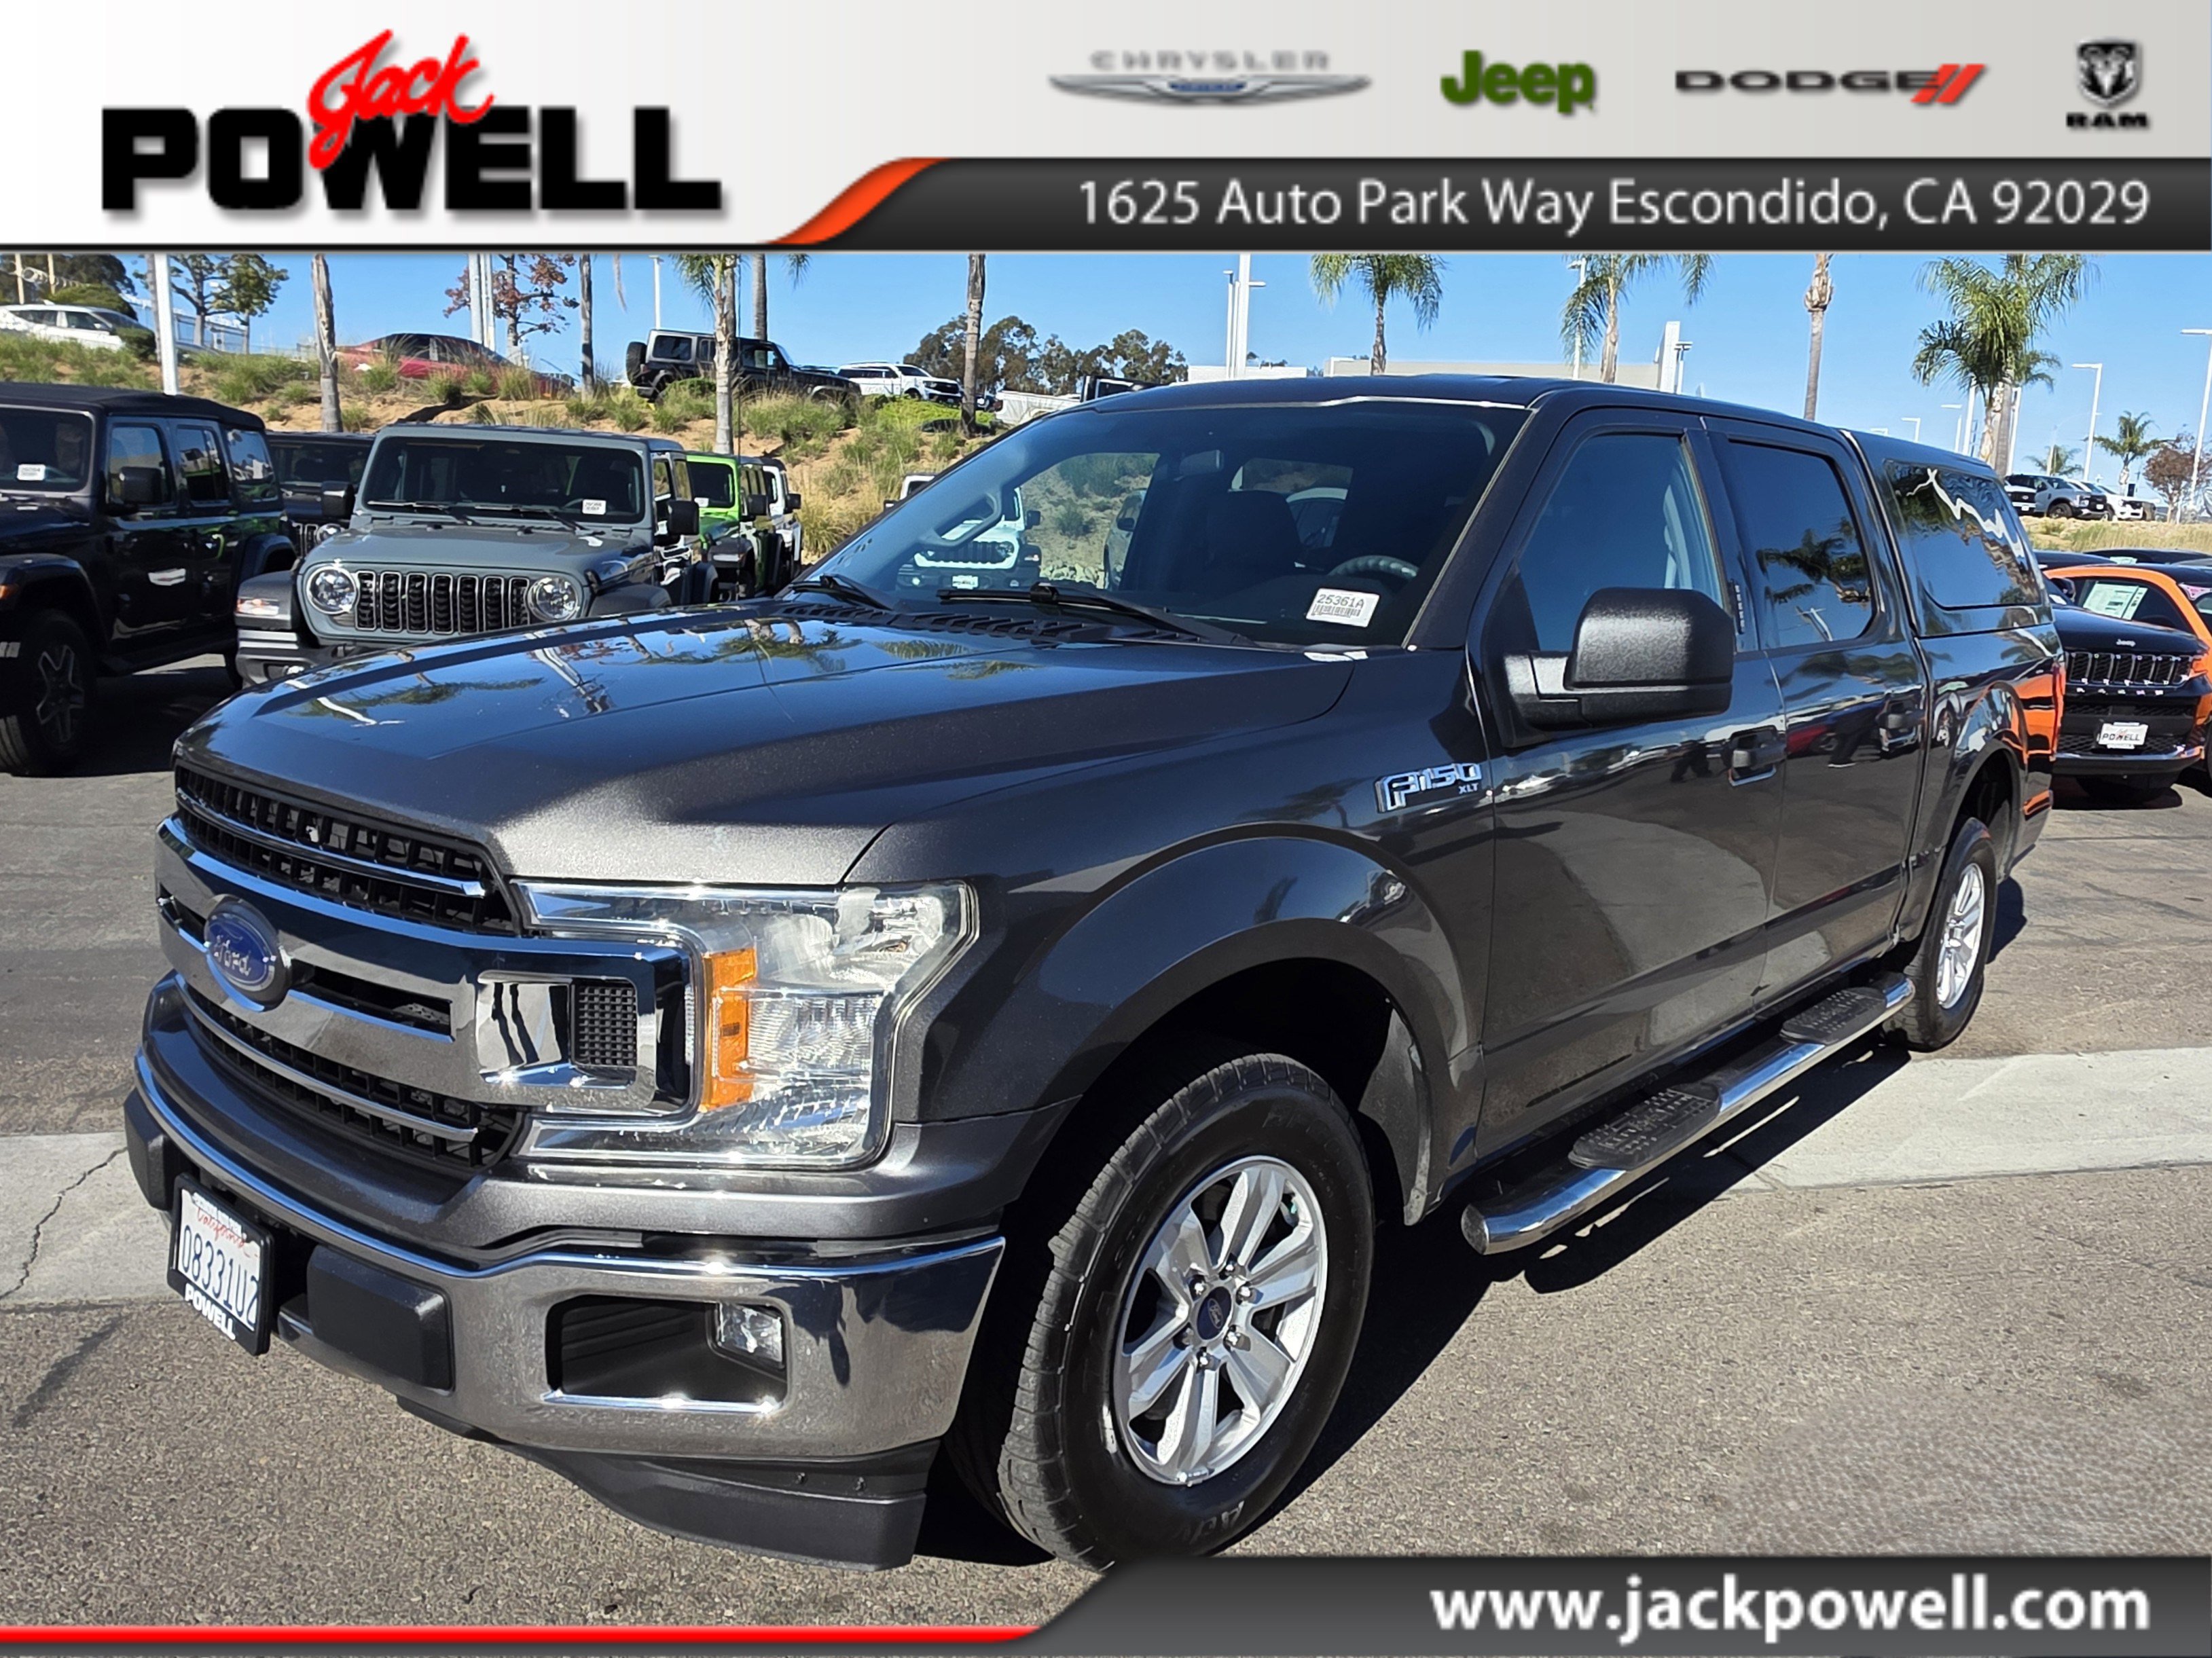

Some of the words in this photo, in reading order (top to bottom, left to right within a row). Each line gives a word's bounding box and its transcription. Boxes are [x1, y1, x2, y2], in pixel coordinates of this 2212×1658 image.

[1317, 593, 1364, 609] 25361A
[1458, 783, 1479, 794] XLT
[185, 1283, 236, 1340] POWELL
